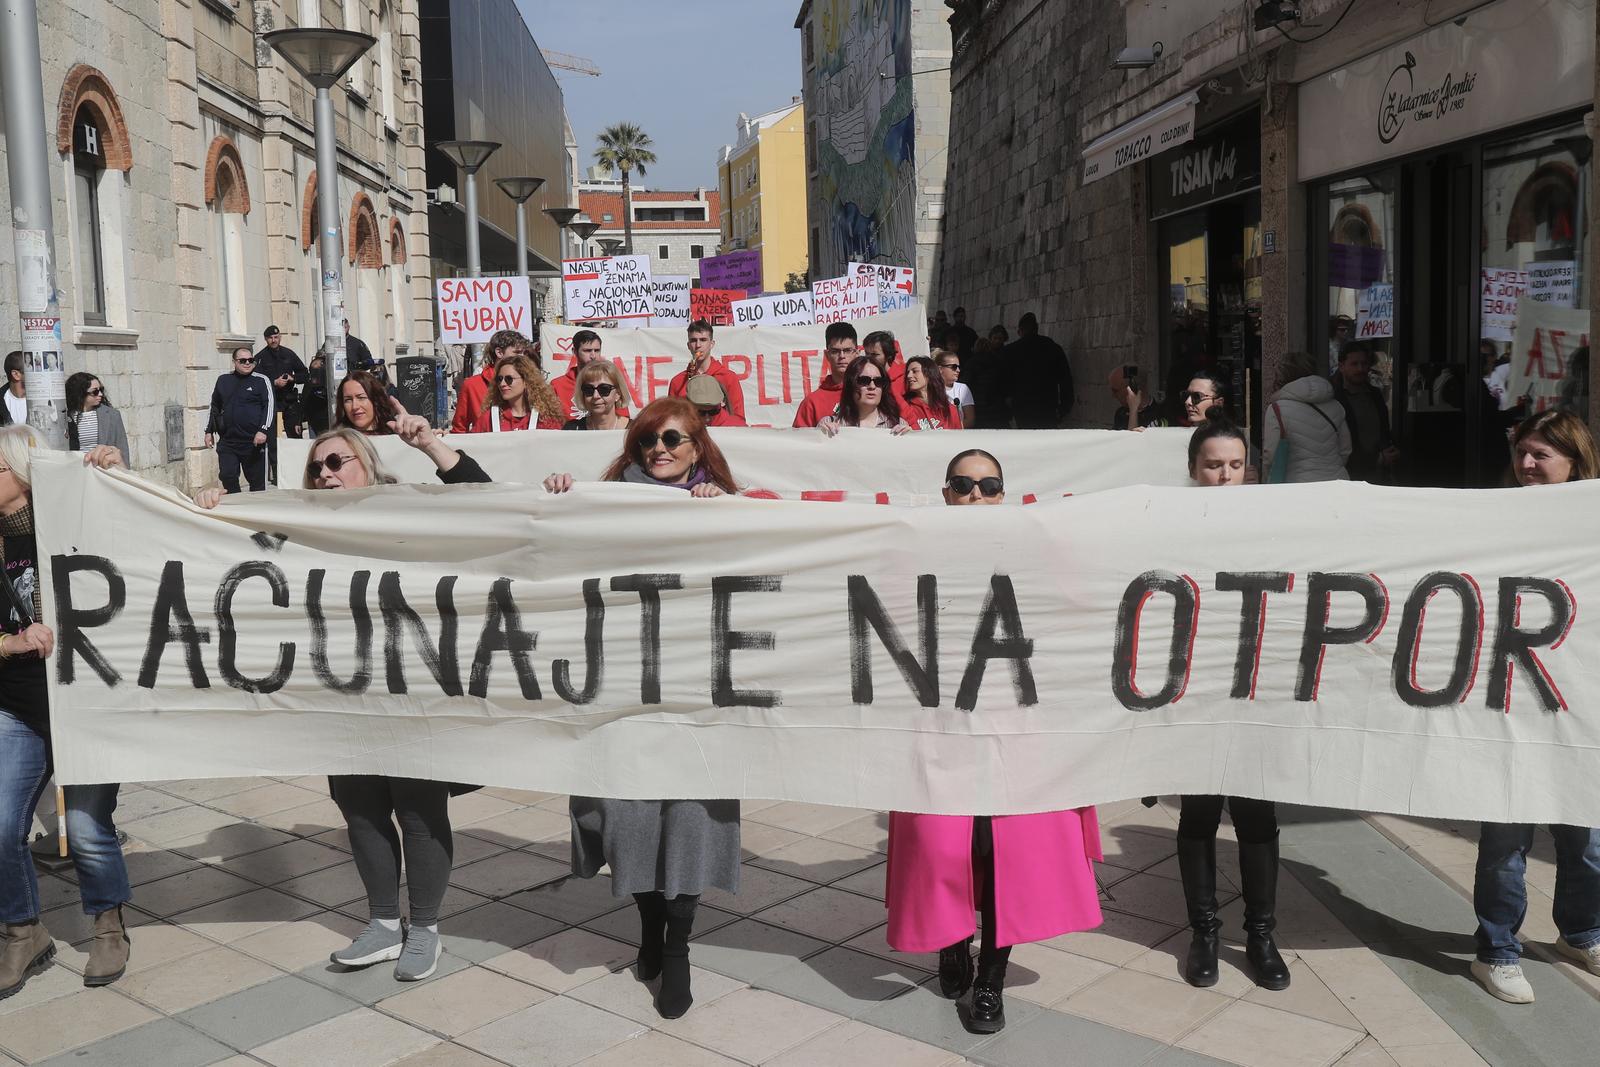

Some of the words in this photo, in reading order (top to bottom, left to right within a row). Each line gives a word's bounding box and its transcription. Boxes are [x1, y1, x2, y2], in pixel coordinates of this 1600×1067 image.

[1113, 134, 1152, 168] TOBACCO
[1170, 146, 1213, 197] TISAK
[569, 260, 609, 274] NASILJE
[616, 259, 637, 271] NAD
[856, 274, 875, 289] DIDE
[441, 280, 513, 303] SAMO
[571, 288, 580, 298] JE
[589, 283, 652, 299] NACIONALNA
[655, 294, 678, 303] NISU
[690, 293, 730, 305] DANAS
[582, 299, 650, 318] SRAMOTA
[815, 294, 838, 310] MOG
[736, 304, 763, 322] BILO
[51, 531, 783, 708] RAČUNAJTE
[848, 571, 1039, 712] NA
[1111, 569, 1577, 713] OTPOR
